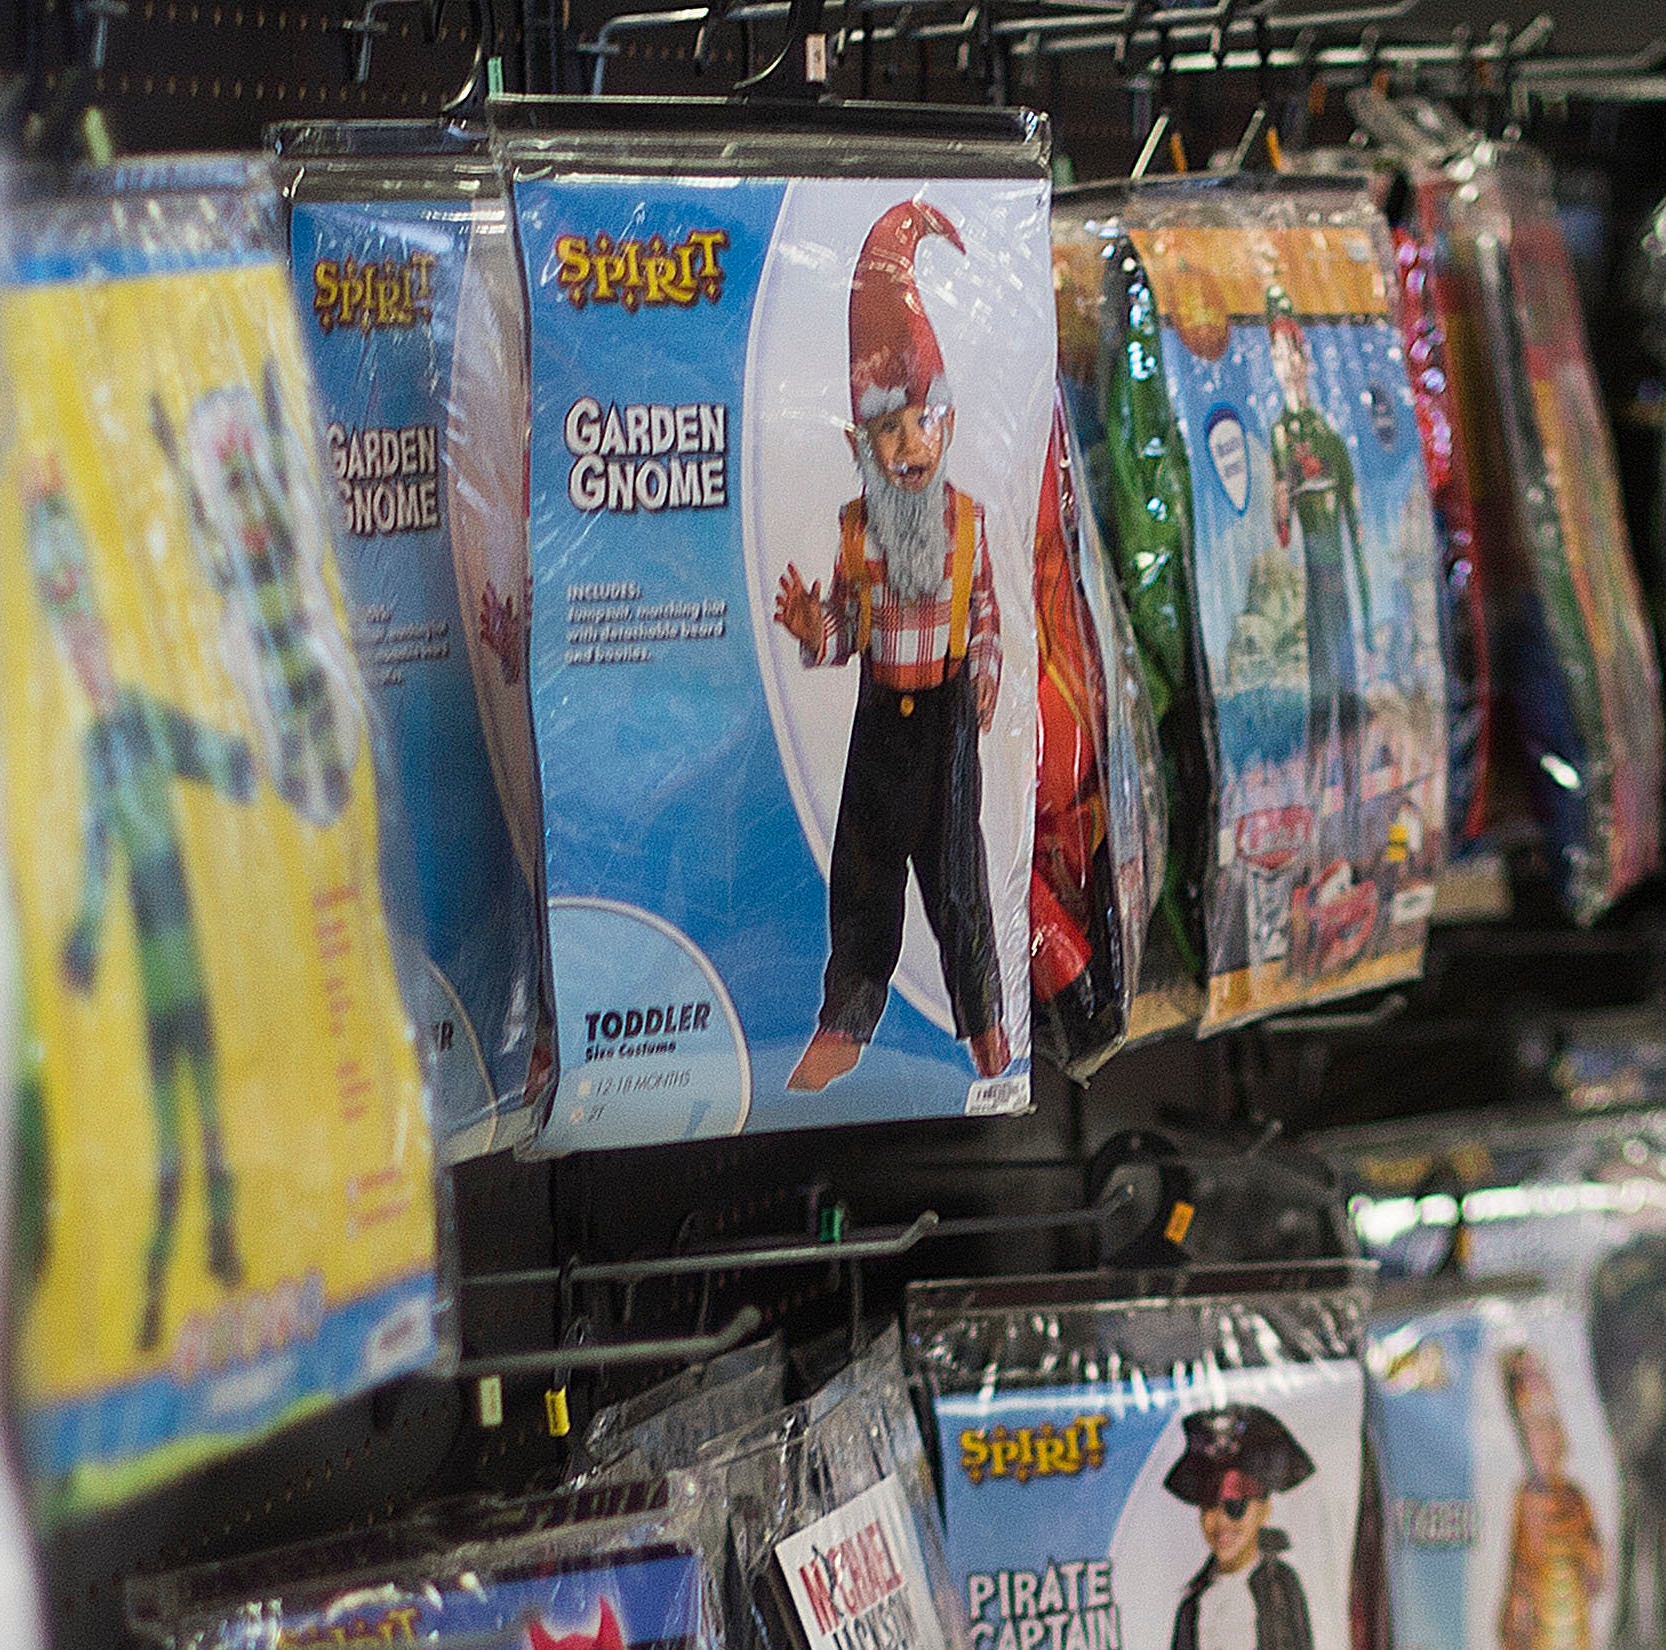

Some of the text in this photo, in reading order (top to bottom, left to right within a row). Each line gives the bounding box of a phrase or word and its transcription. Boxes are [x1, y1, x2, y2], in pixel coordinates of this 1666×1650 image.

[312, 252, 435, 335] SPIRIT
[556, 227, 730, 312] SPIRIT
[327, 422, 438, 479] GARDEN
[564, 396, 728, 459] GARDEN
[567, 452, 728, 512] GNOME
[584, 1002, 711, 1043] TODDLER
[618, 1040, 677, 1059] Costume
[959, 1414, 1110, 1484] SPIRIT
[967, 1557, 1113, 1623] PIRATE
